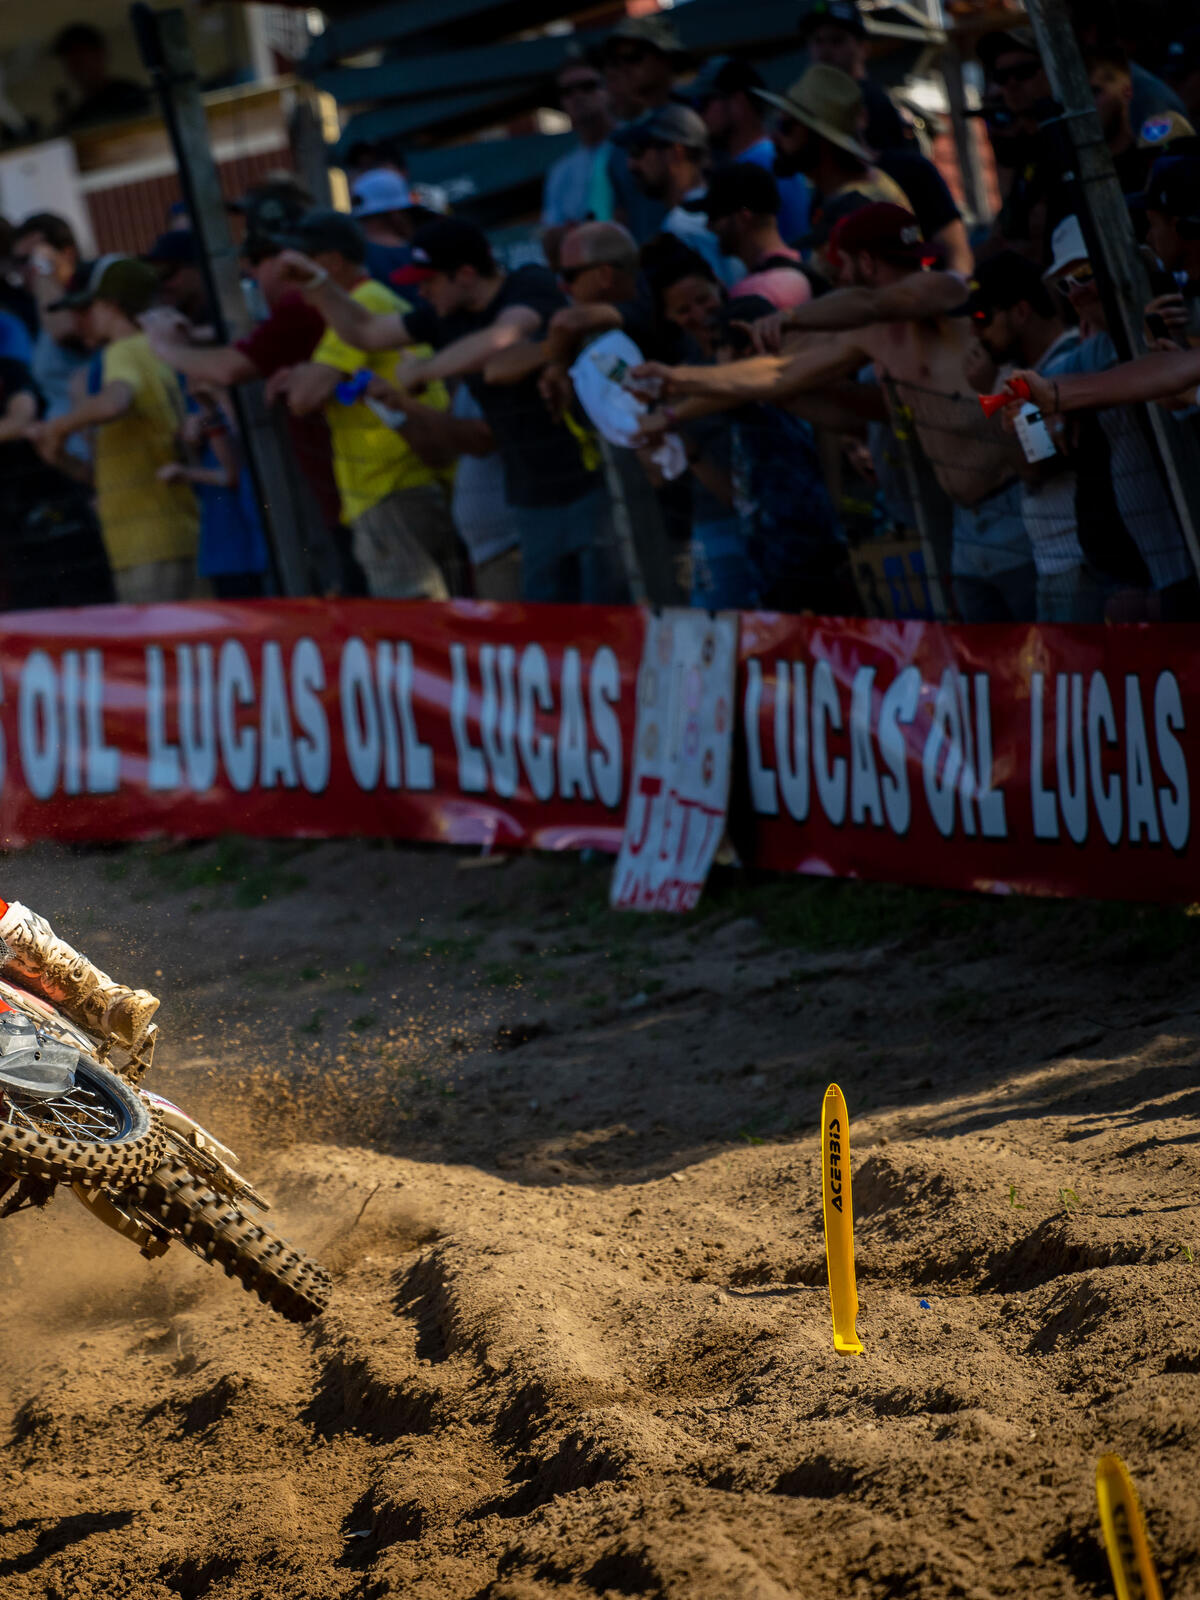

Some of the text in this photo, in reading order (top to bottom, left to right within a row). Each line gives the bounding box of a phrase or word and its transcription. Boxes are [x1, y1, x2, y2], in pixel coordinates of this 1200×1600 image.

[19, 648, 121, 799] OIL
[145, 637, 331, 794] LUCAS
[339, 636, 436, 791] OIL
[449, 642, 622, 808] LUCAS
[745, 657, 922, 835] LUCAS
[923, 666, 1008, 837] OIL
[1030, 669, 1190, 852] LUCAS
